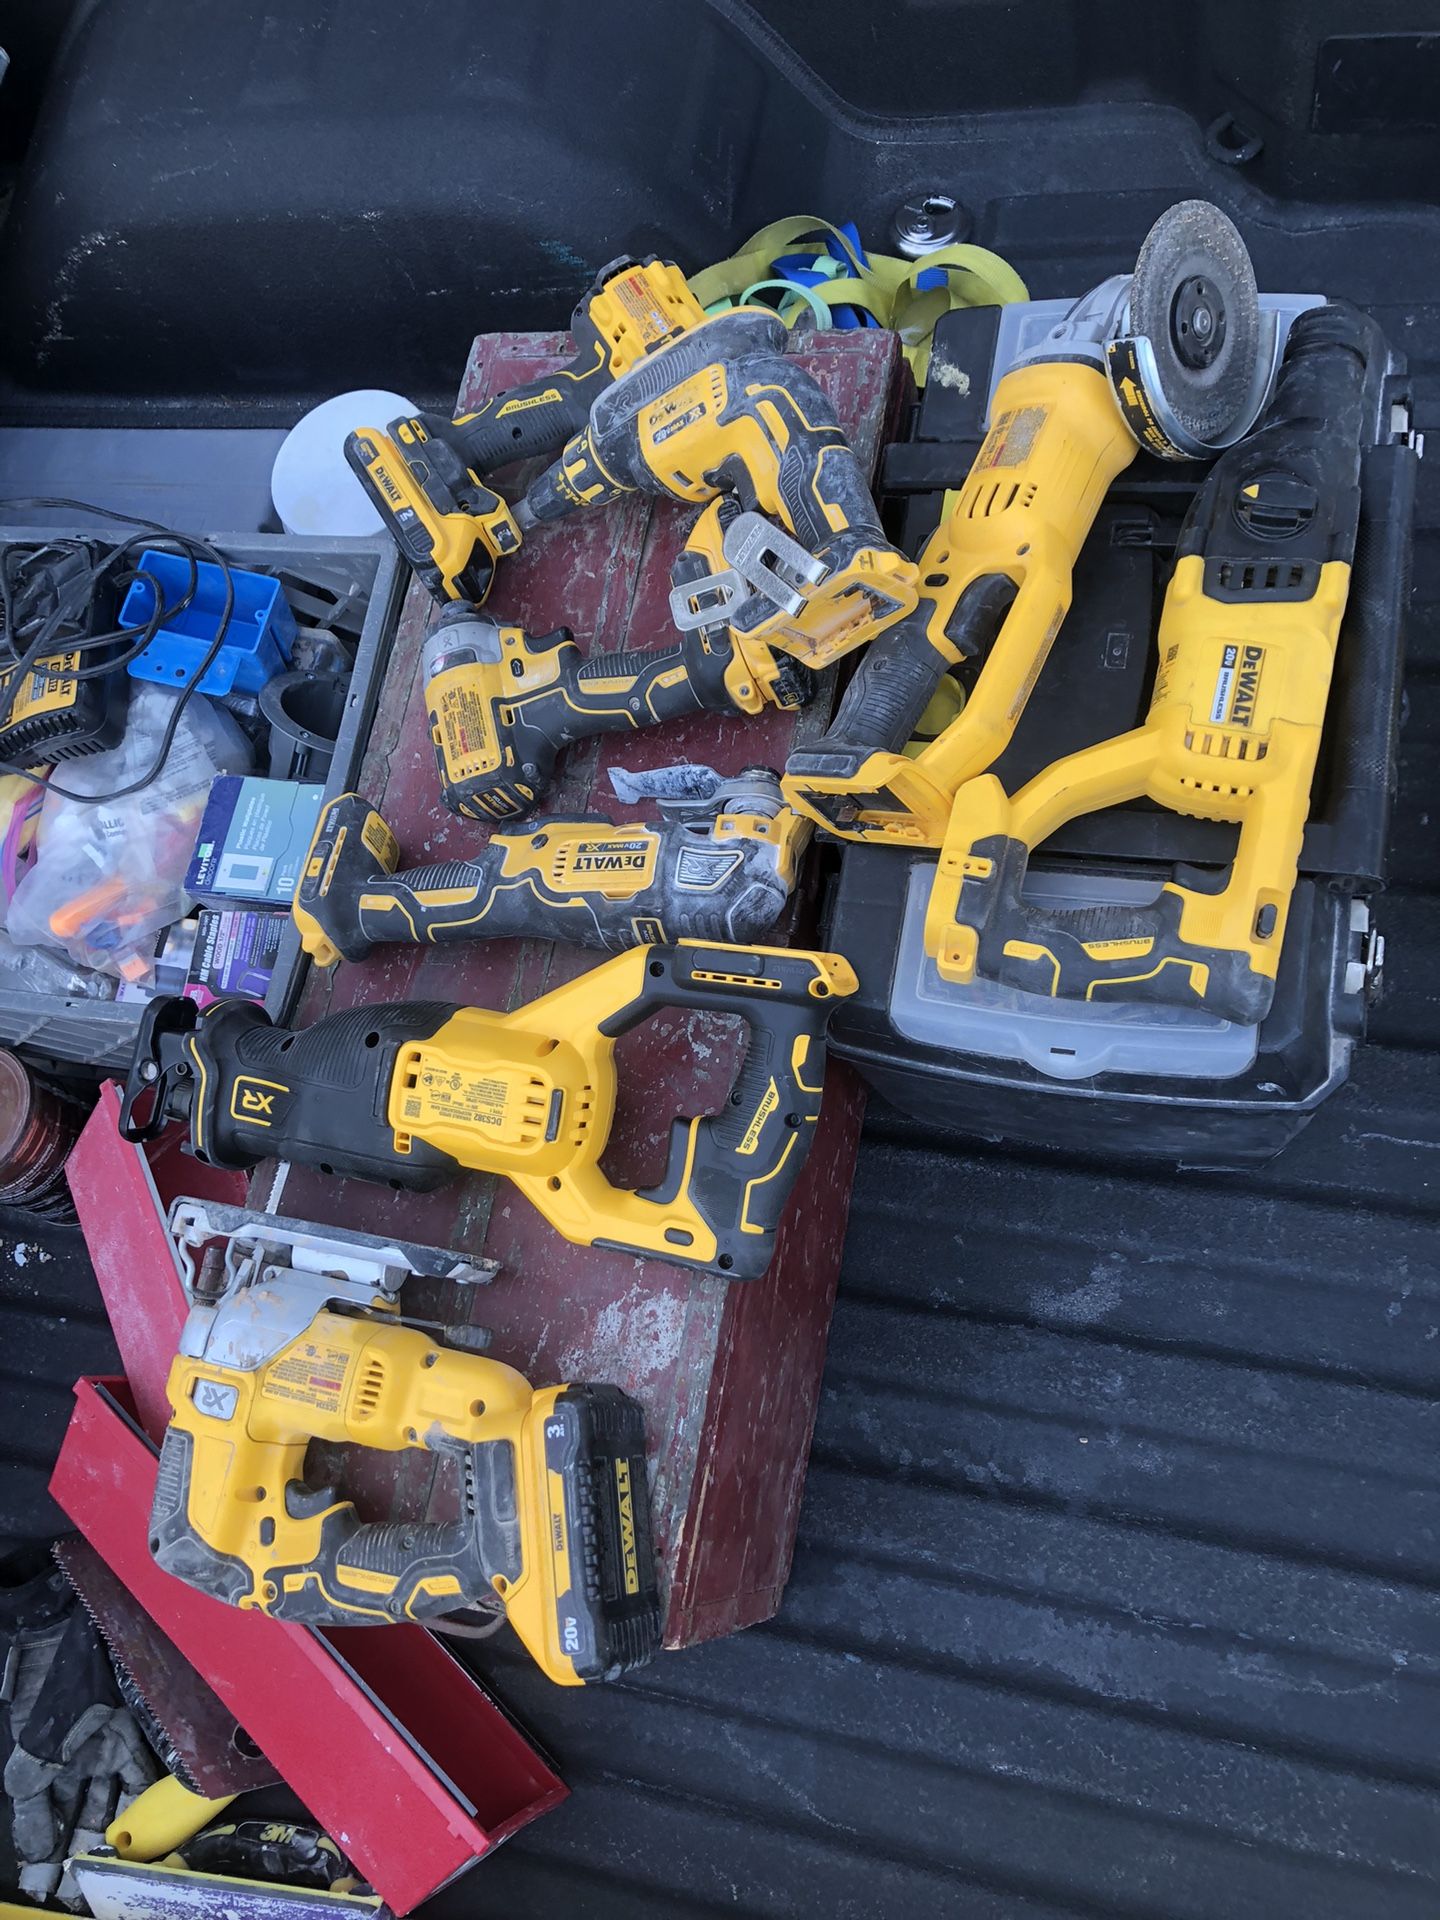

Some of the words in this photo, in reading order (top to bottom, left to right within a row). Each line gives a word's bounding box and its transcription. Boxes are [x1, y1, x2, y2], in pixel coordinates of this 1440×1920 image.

[504, 392, 557, 412] BRUSHLESS
[401, 507, 414, 520] 2
[1223, 646, 1236, 666] 20V
[1214, 670, 1230, 720] BRUSHLESS
[1230, 644, 1263, 726] DEWALT
[585, 842, 601, 851] XR
[194, 841, 215, 886] LEVITON
[572, 854, 645, 869] DEWALT
[274, 874, 295, 895] 10
[205, 913, 220, 945] Staples
[1086, 937, 1151, 949] BRUSHLESS
[200, 943, 214, 969] Cable
[197, 967, 210, 982] NM
[239, 1088, 275, 1114] XR
[473, 1112, 502, 1126] DCS382
[741, 1089, 777, 1152] BRUSHLESS
[202, 1385, 230, 1411] XR
[546, 1423, 560, 1438] 3
[554, 1513, 563, 1552] DEWALT
[614, 1457, 641, 1596] DEWALT
[564, 1617, 580, 1651] 20V
[258, 1823, 296, 1844] 3M
